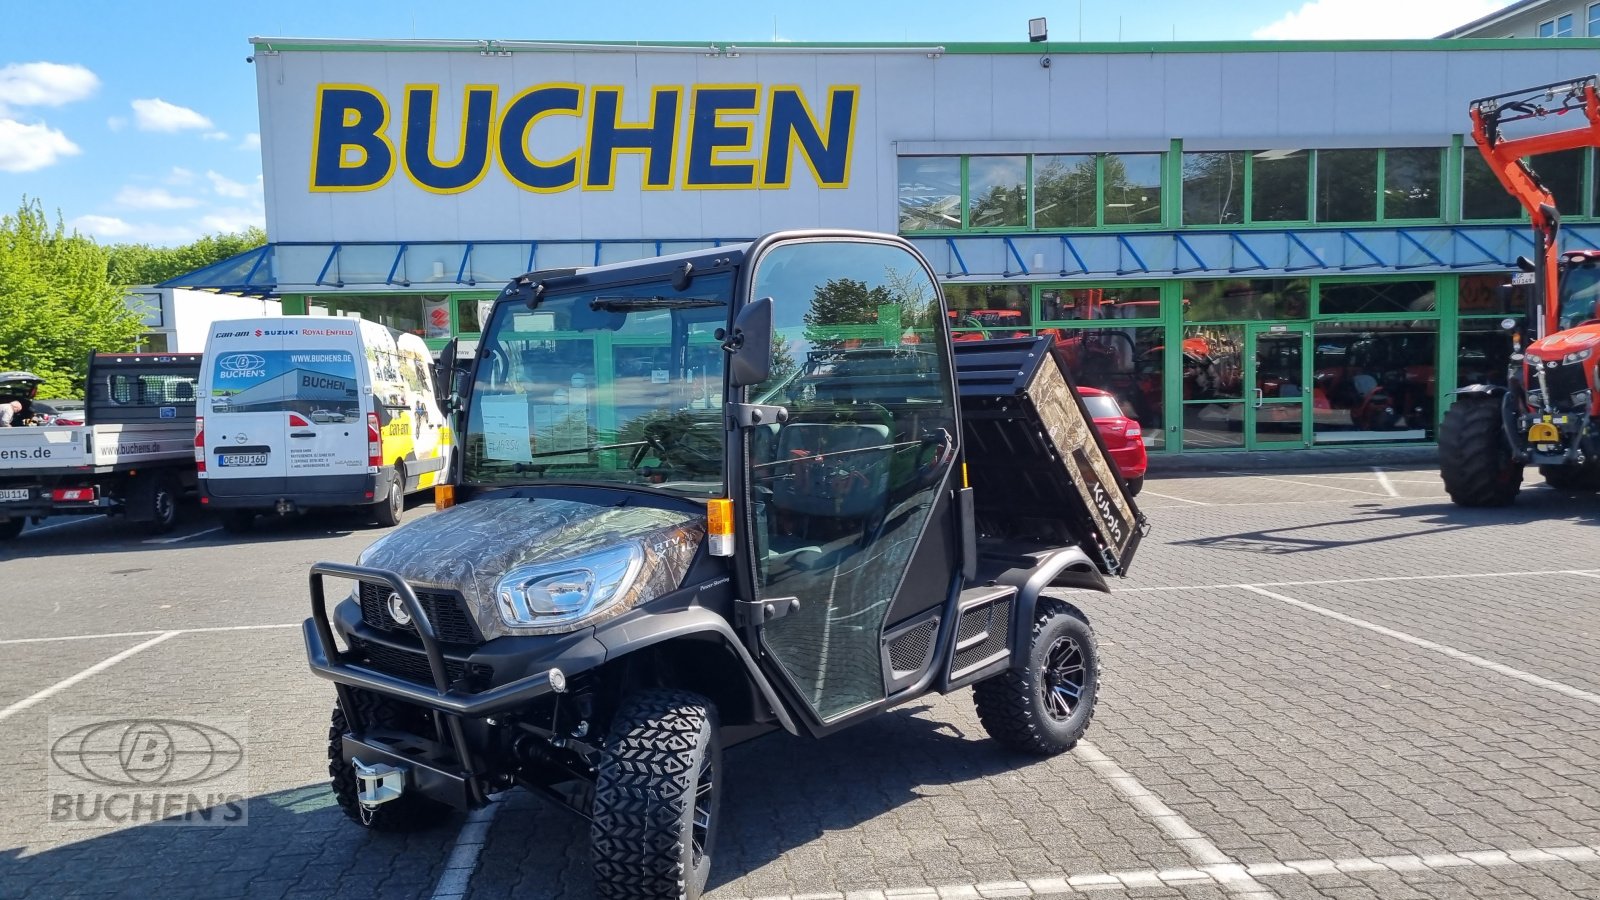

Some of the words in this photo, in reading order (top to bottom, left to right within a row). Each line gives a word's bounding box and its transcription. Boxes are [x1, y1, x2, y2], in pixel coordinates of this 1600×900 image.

[309, 82, 861, 194] BUCHEN
[215, 331, 250, 339] can-am
[291, 354, 352, 363] WWW.BUCHENS.DE
[220, 369, 266, 379] BUCHEN'S
[302, 375, 346, 391] BUCHEN
[101, 442, 161, 456] www.buchens.de
[1094, 482, 1121, 542] Kubota
[654, 536, 680, 551] RTV
